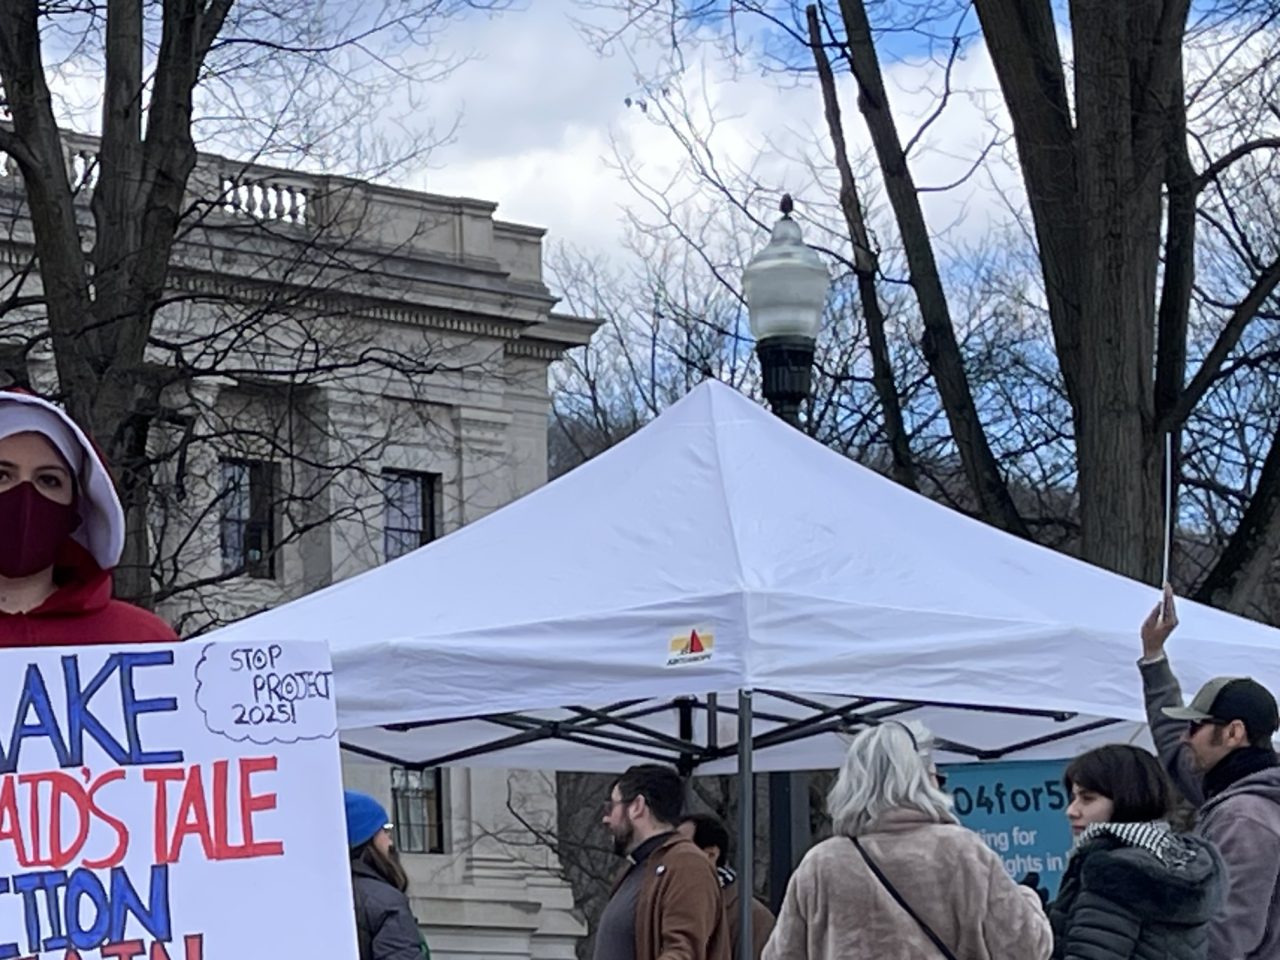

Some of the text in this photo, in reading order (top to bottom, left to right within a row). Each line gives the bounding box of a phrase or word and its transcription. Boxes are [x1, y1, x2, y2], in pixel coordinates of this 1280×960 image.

[230, 644, 282, 671] STOP
[253, 671, 333, 703] PROJECT
[144, 756, 283, 864] TALE
[977, 826, 1038, 851] ing for
[1000, 853, 1043, 877] ghts
[1046, 851, 1063, 871] in
